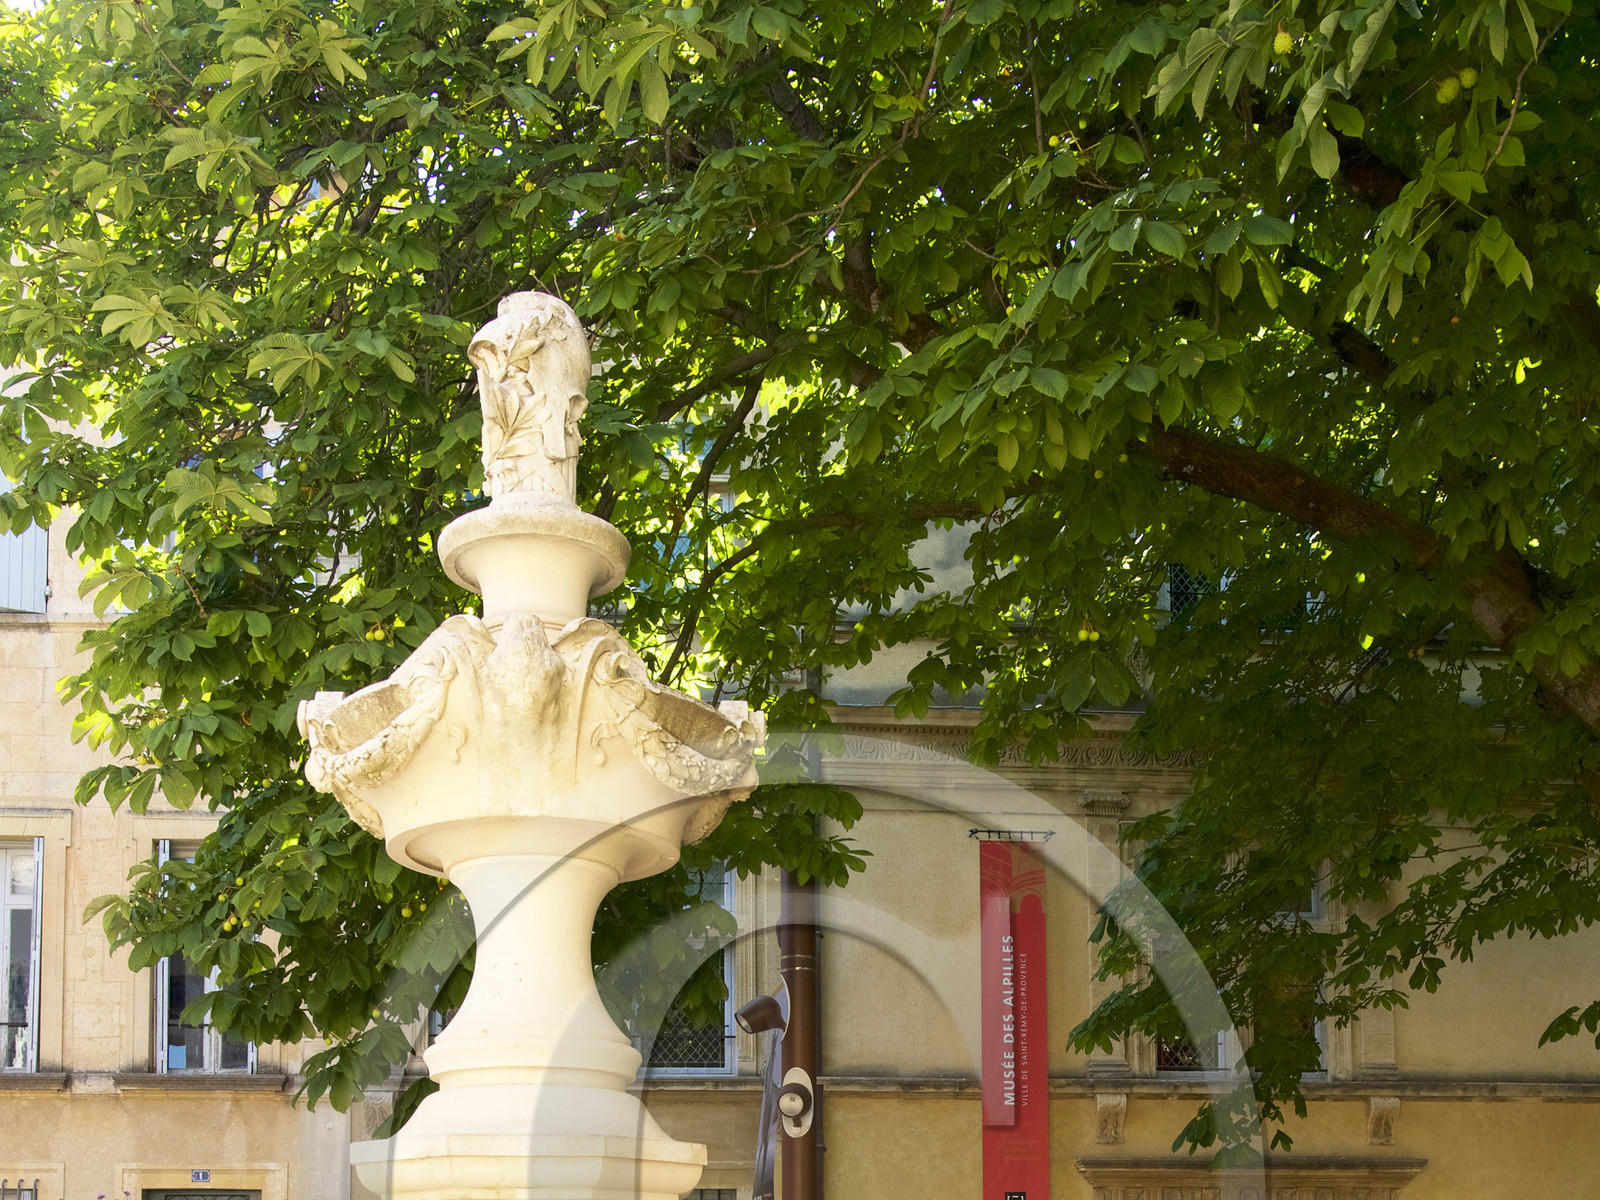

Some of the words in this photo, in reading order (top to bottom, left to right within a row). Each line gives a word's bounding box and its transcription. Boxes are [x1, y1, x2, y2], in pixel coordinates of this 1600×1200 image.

[1002, 935, 1014, 1006] ALPILLES
[1003, 1014, 1014, 1043] DES
[1001, 1051, 1015, 1106] MUSÉE
[1021, 1070, 1028, 1080] DE
